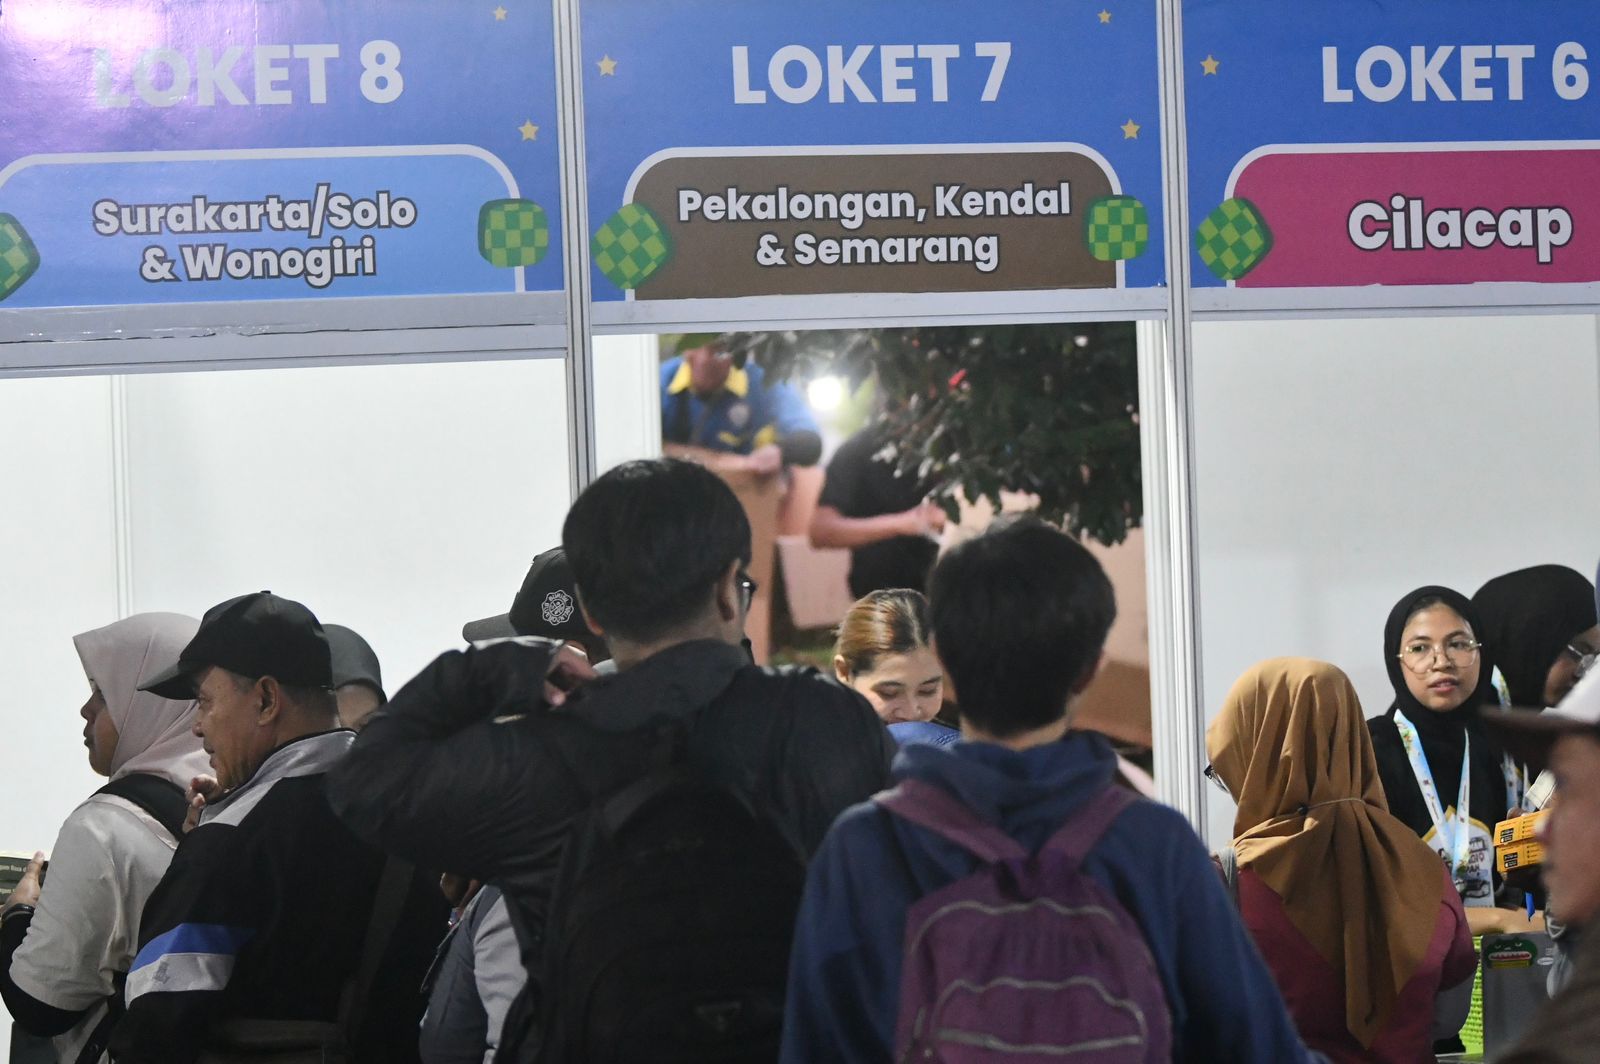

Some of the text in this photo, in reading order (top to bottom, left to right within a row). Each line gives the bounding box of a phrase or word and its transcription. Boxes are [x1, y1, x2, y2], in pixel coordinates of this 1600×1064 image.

[93, 39, 404, 109] LOKET 8
[732, 42, 1012, 105] LOKET 7
[1321, 41, 1590, 103] LOKET 6
[92, 183, 418, 239] Surakarta/Solo
[677, 182, 1072, 231] Pekalongan, Kendal
[1346, 193, 1573, 264] Cilacap
[140, 236, 377, 289] & Wonogiri
[755, 232, 999, 273] & Semarang
